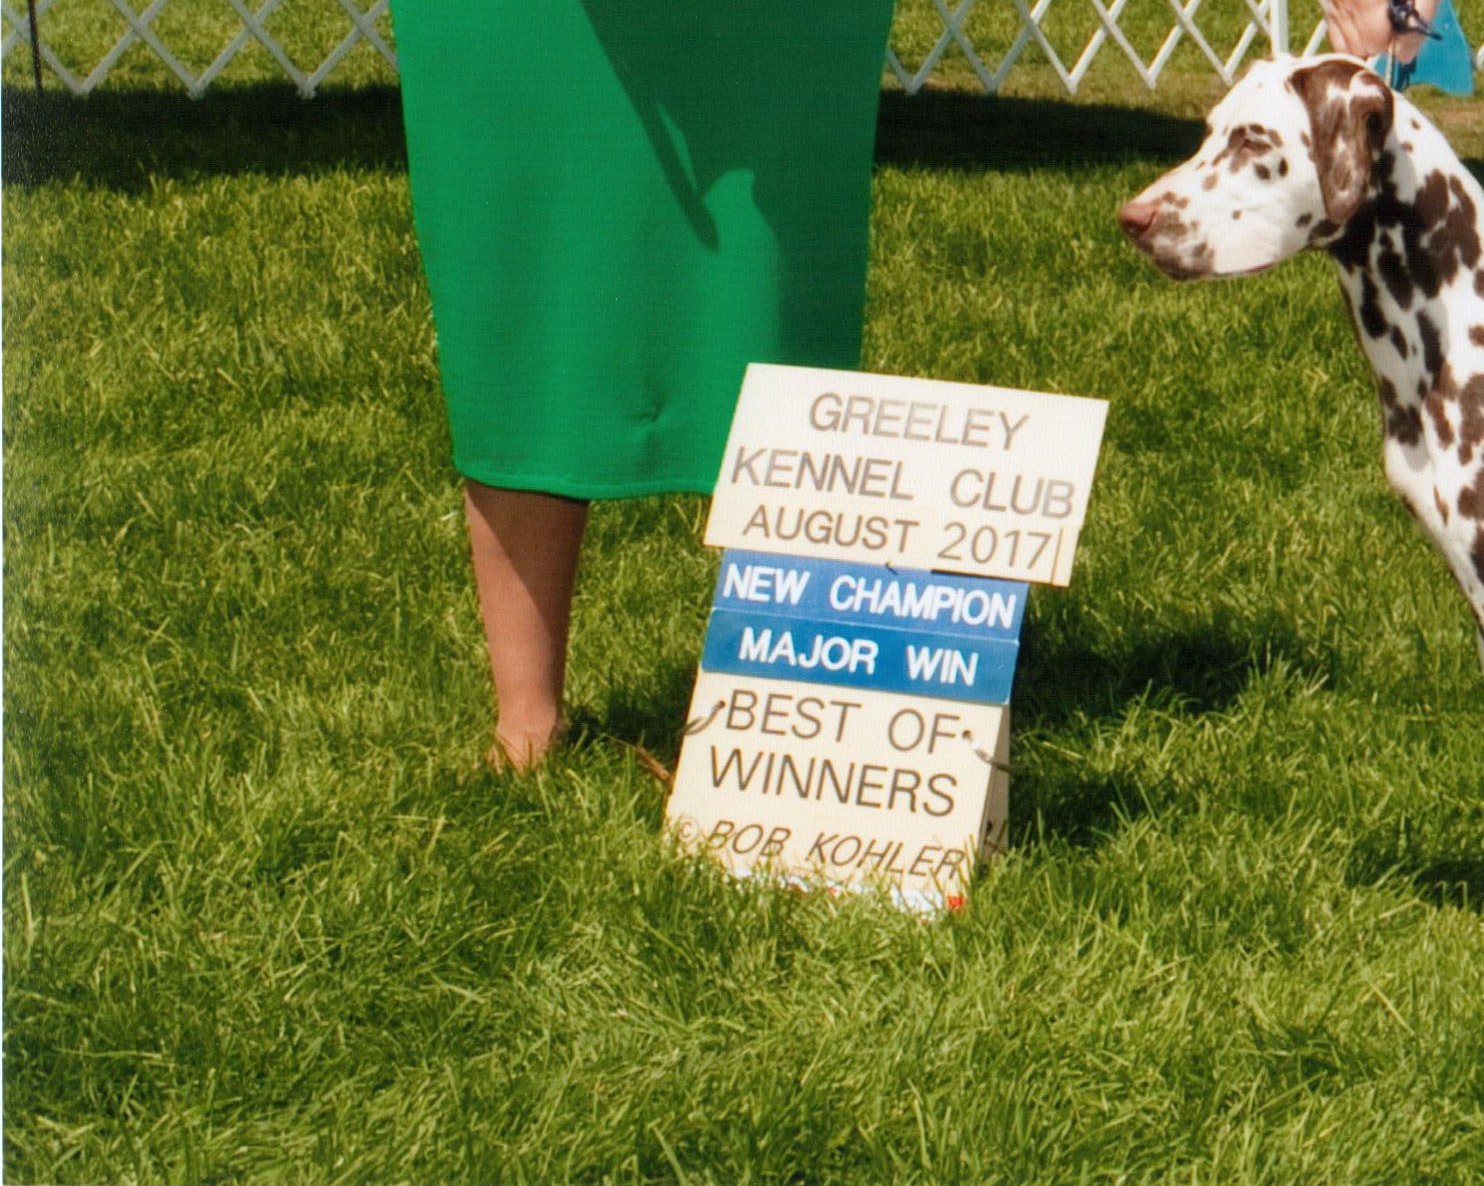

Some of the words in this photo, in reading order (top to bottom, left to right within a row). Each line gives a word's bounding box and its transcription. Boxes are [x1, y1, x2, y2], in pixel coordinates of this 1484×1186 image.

[809, 392, 1031, 451] GREELEY
[731, 446, 915, 501] KENNEL
[949, 469, 1076, 520] CLUB
[742, 504, 920, 553] AUGUST
[937, 522, 1053, 571] 2017
[722, 564, 811, 606] NEW
[829, 574, 1016, 628] CHAMPION
[738, 628, 879, 675] MAJOR
[906, 645, 979, 686] WIN
[725, 689, 862, 742] BEST
[888, 708, 961, 754] OF
[710, 745, 958, 817] WINNERS
[707, 819, 792, 856] BOB
[805, 832, 966, 880] KOHLER
